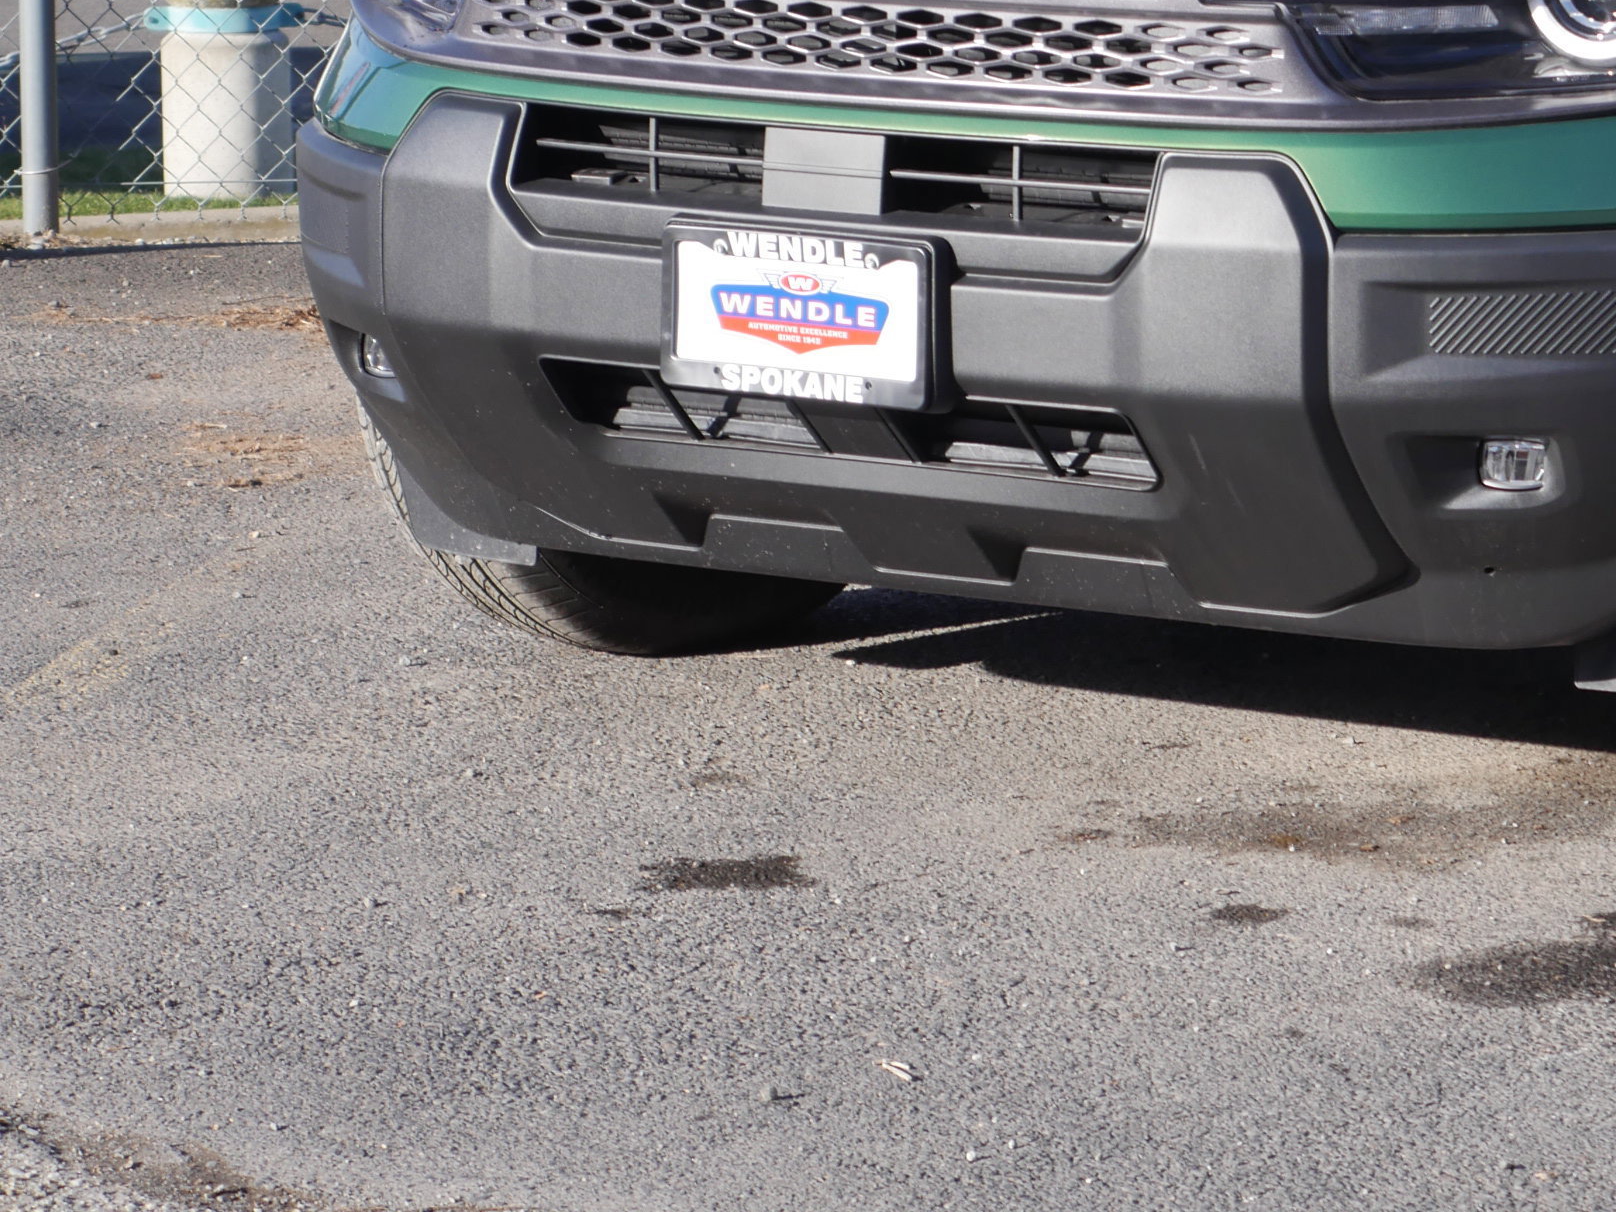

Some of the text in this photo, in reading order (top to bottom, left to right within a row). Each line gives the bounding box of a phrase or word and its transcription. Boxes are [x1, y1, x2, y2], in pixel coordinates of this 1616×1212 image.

[726, 231, 864, 269] WENDLE
[719, 292, 877, 328] WENDLE
[748, 321, 849, 339] AUTOMOTIVE EXCELLENCE
[777, 333, 801, 343] SINCE
[721, 363, 864, 404] SPOKANE
